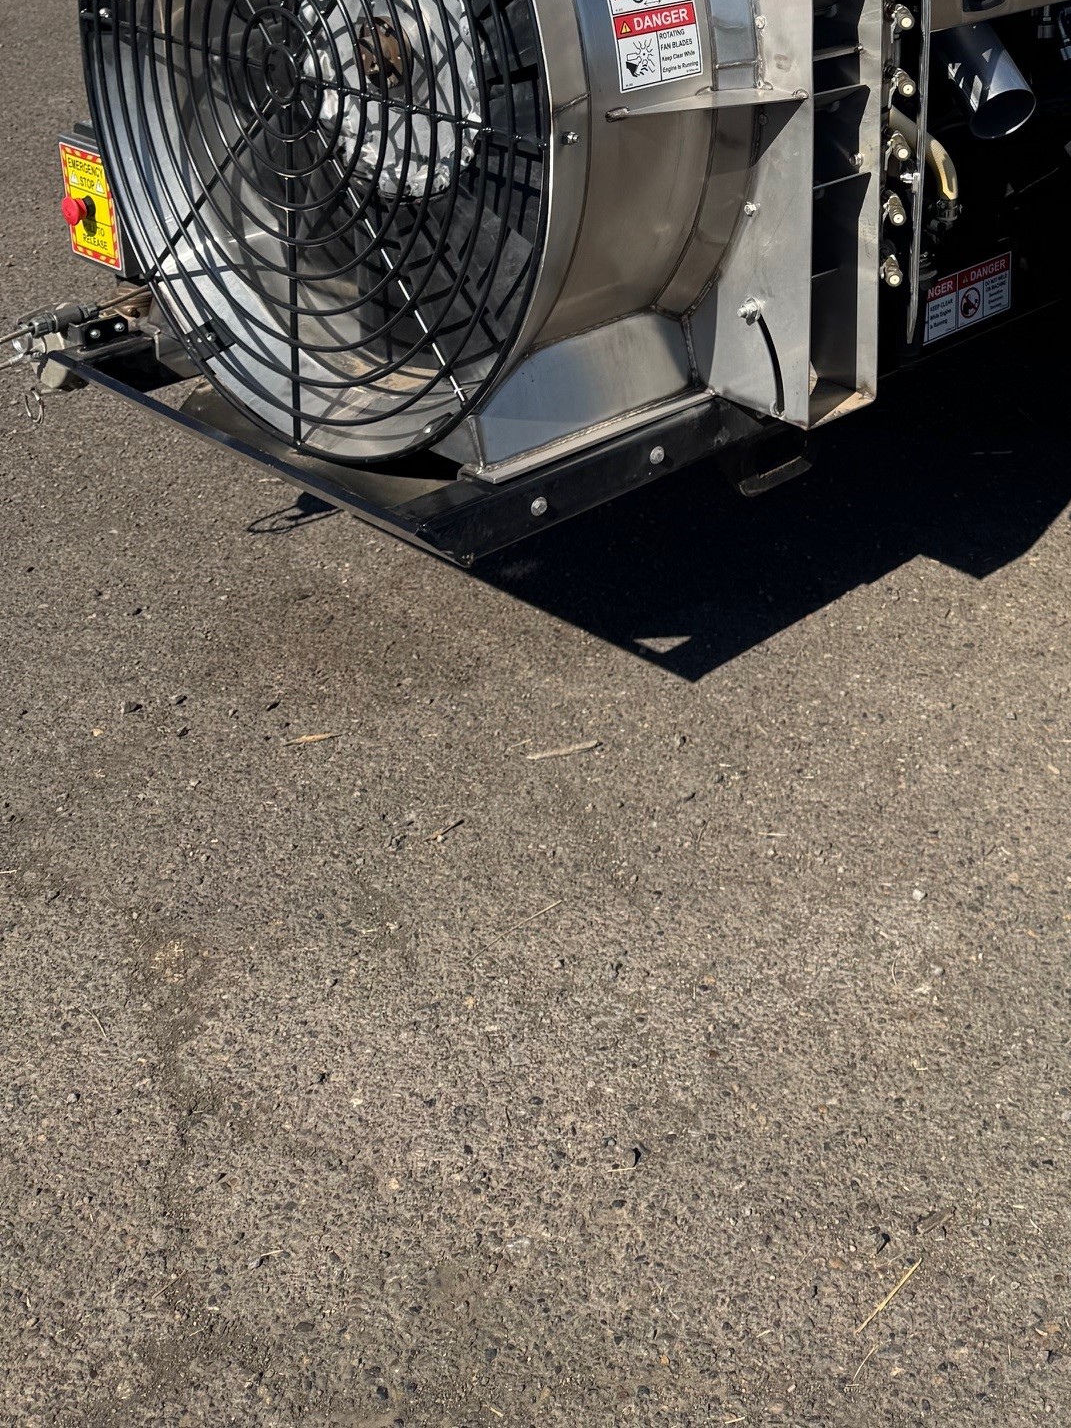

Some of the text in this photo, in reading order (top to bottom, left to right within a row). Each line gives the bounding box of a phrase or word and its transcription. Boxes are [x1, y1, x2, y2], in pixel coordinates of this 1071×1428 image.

[633, 9, 689, 31] DANGER
[659, 29, 685, 40] ROTATING
[660, 38, 693, 51] FAN BLADES
[662, 54, 672, 62] Keep
[682, 61, 699, 70] Running
[67, 158, 103, 179] EMERGENCY
[79, 176, 95, 190] STOP
[97, 227, 105, 237] TO
[83, 233, 108, 250] RELEASE
[970, 259, 1006, 281] DANGER
[928, 281, 953, 298] NGER
